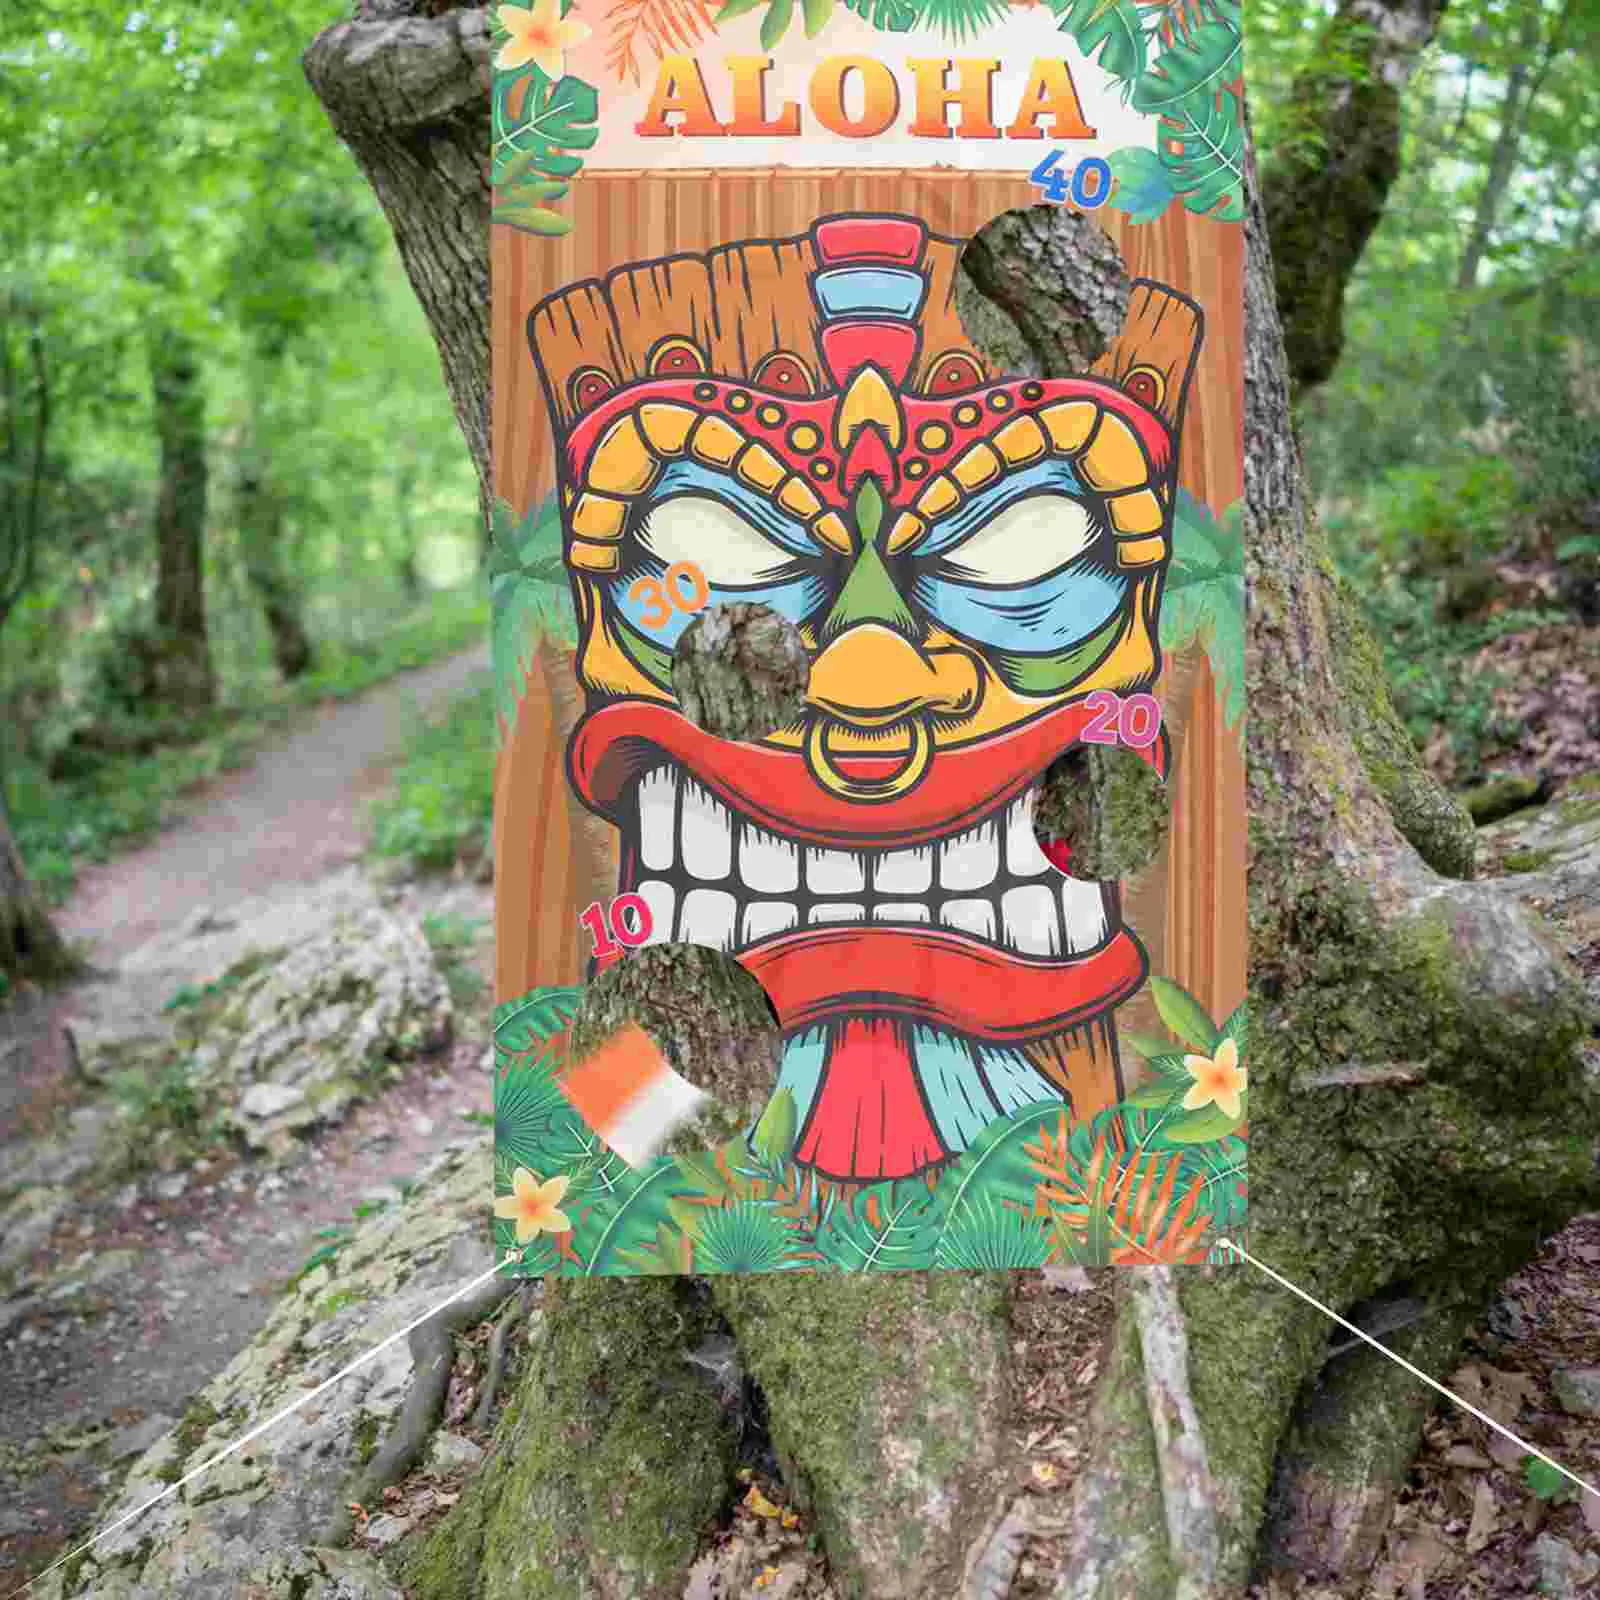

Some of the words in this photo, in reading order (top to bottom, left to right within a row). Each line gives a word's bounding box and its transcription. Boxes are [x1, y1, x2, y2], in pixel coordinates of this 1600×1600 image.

[633, 54, 1098, 139] ALOHA
[1029, 149, 1112, 208] 40
[628, 560, 708, 630] 30
[1080, 690, 1160, 748] 20
[578, 892, 654, 958] 10
